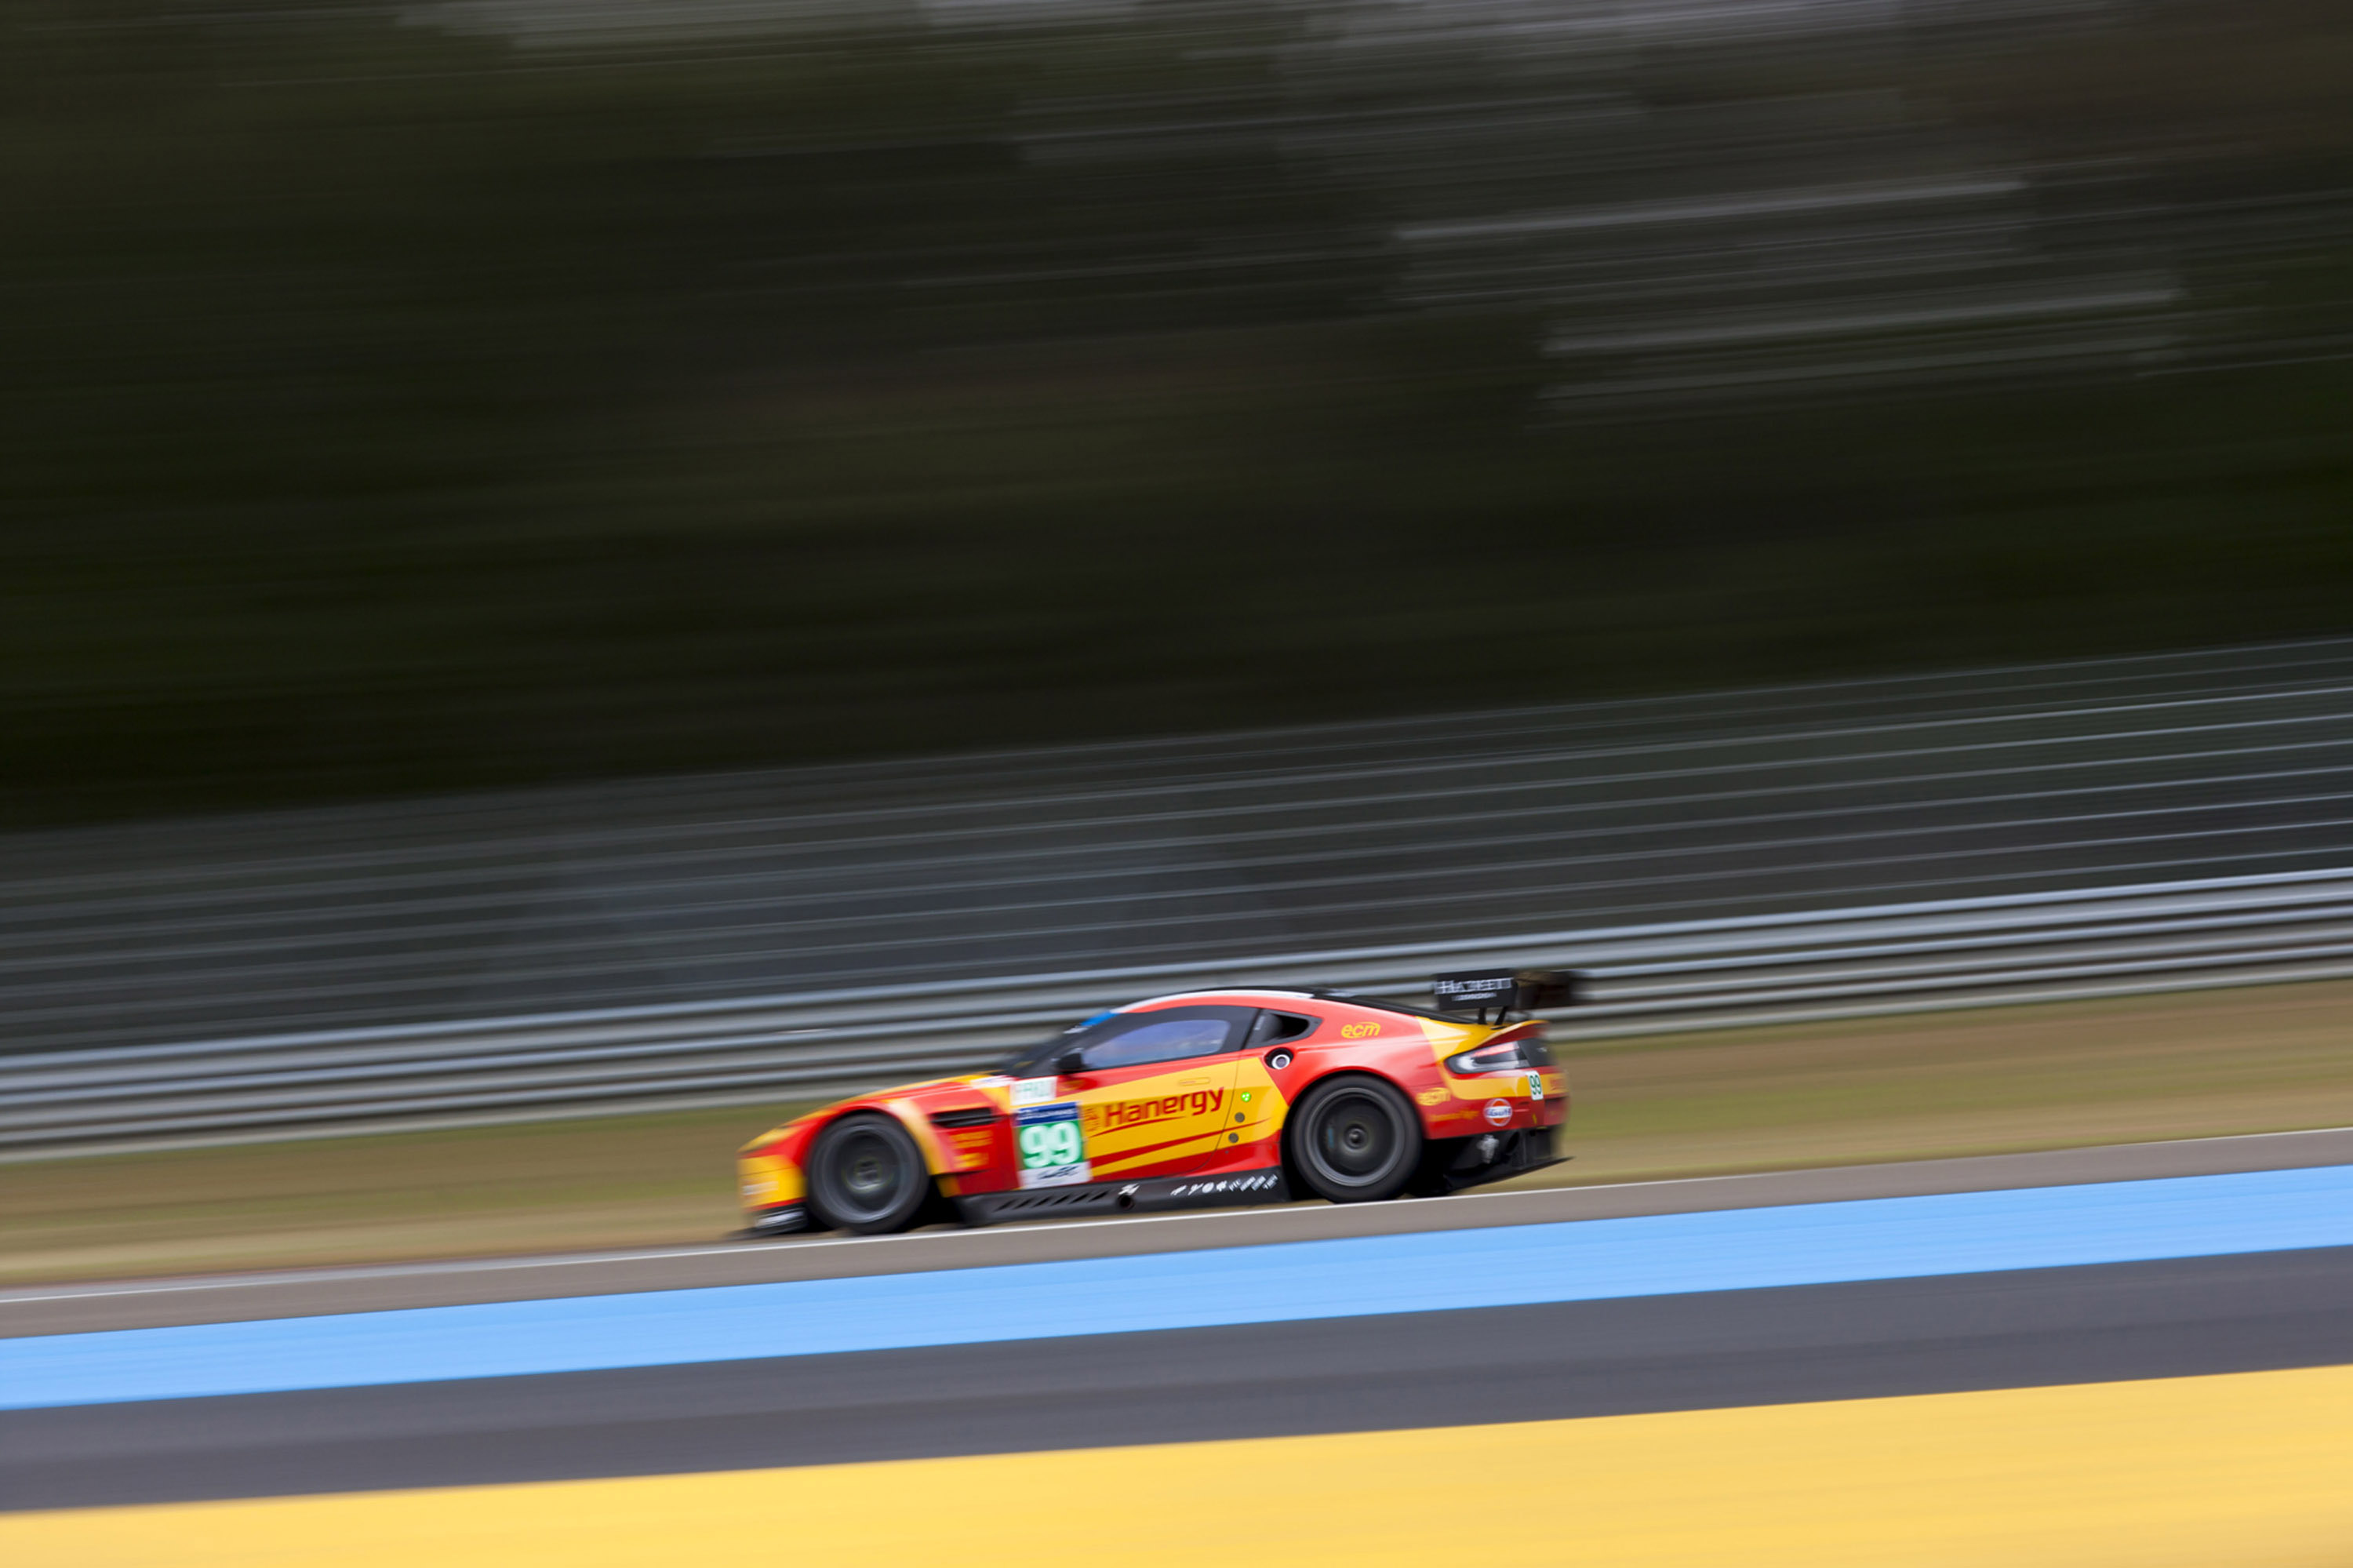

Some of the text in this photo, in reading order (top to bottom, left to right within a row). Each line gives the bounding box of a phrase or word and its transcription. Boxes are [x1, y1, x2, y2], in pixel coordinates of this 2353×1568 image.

[1340, 1021, 1381, 1039] ecm
[1529, 1075, 1542, 1095] 99
[1104, 1086, 1224, 1127] Hanergy
[1020, 1122, 1082, 1169] 99
